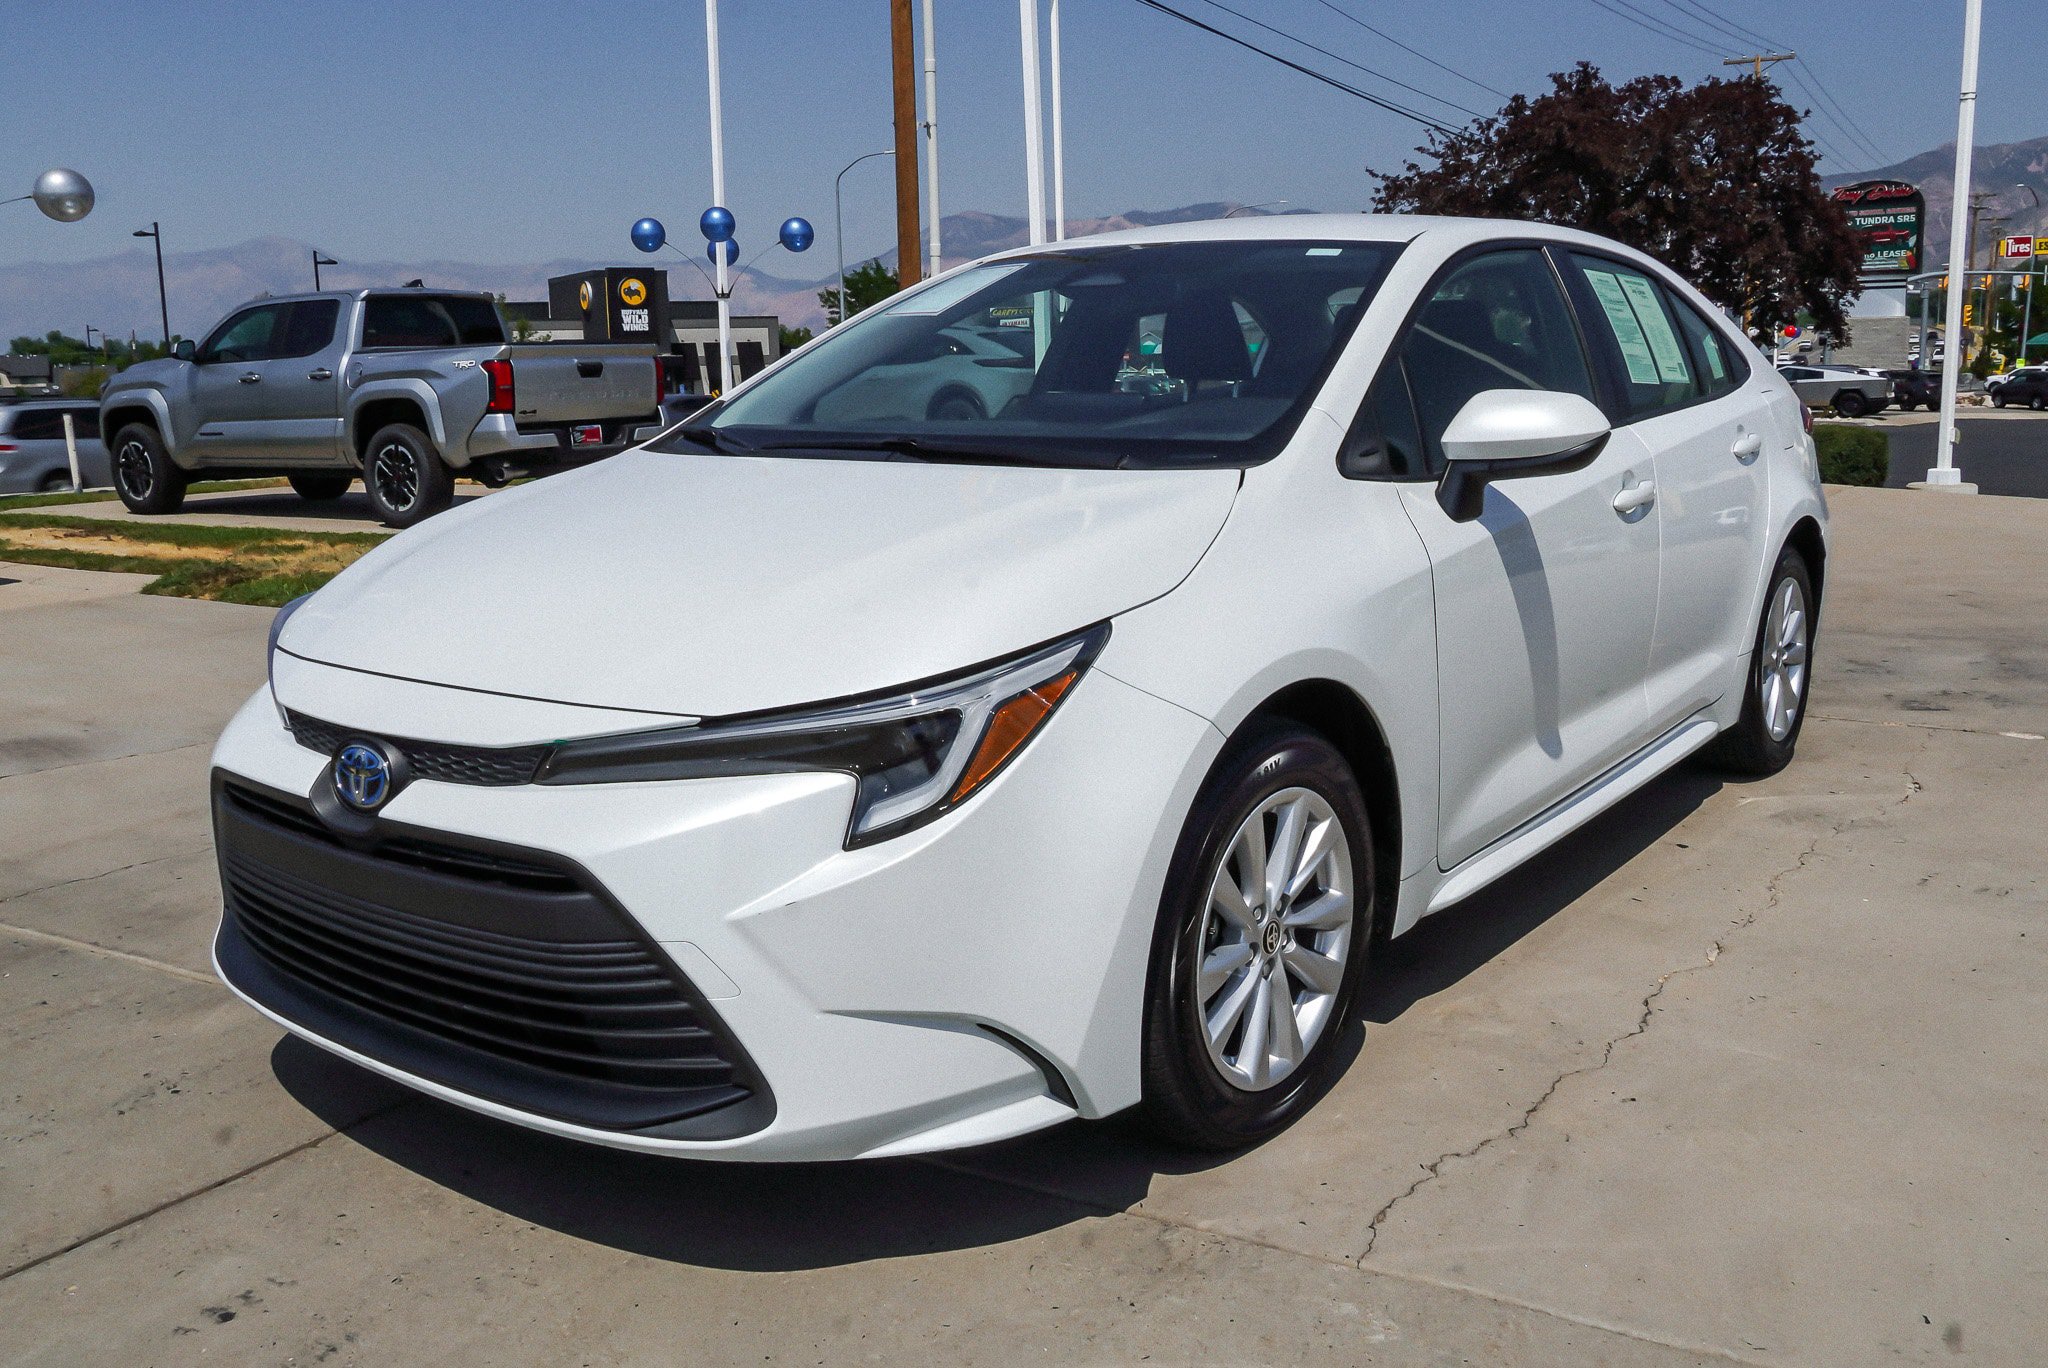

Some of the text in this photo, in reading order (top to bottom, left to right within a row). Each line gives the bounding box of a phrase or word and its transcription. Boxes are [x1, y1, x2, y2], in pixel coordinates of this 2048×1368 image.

[1855, 216, 1895, 225] TUNDRA
[1897, 214, 1916, 223] SR5
[2007, 239, 2031, 256] Tires
[1877, 250, 1908, 258] LEASE
[622, 314, 649, 324] WILD
[622, 323, 650, 332] WINGS
[452, 360, 476, 369] TRD
